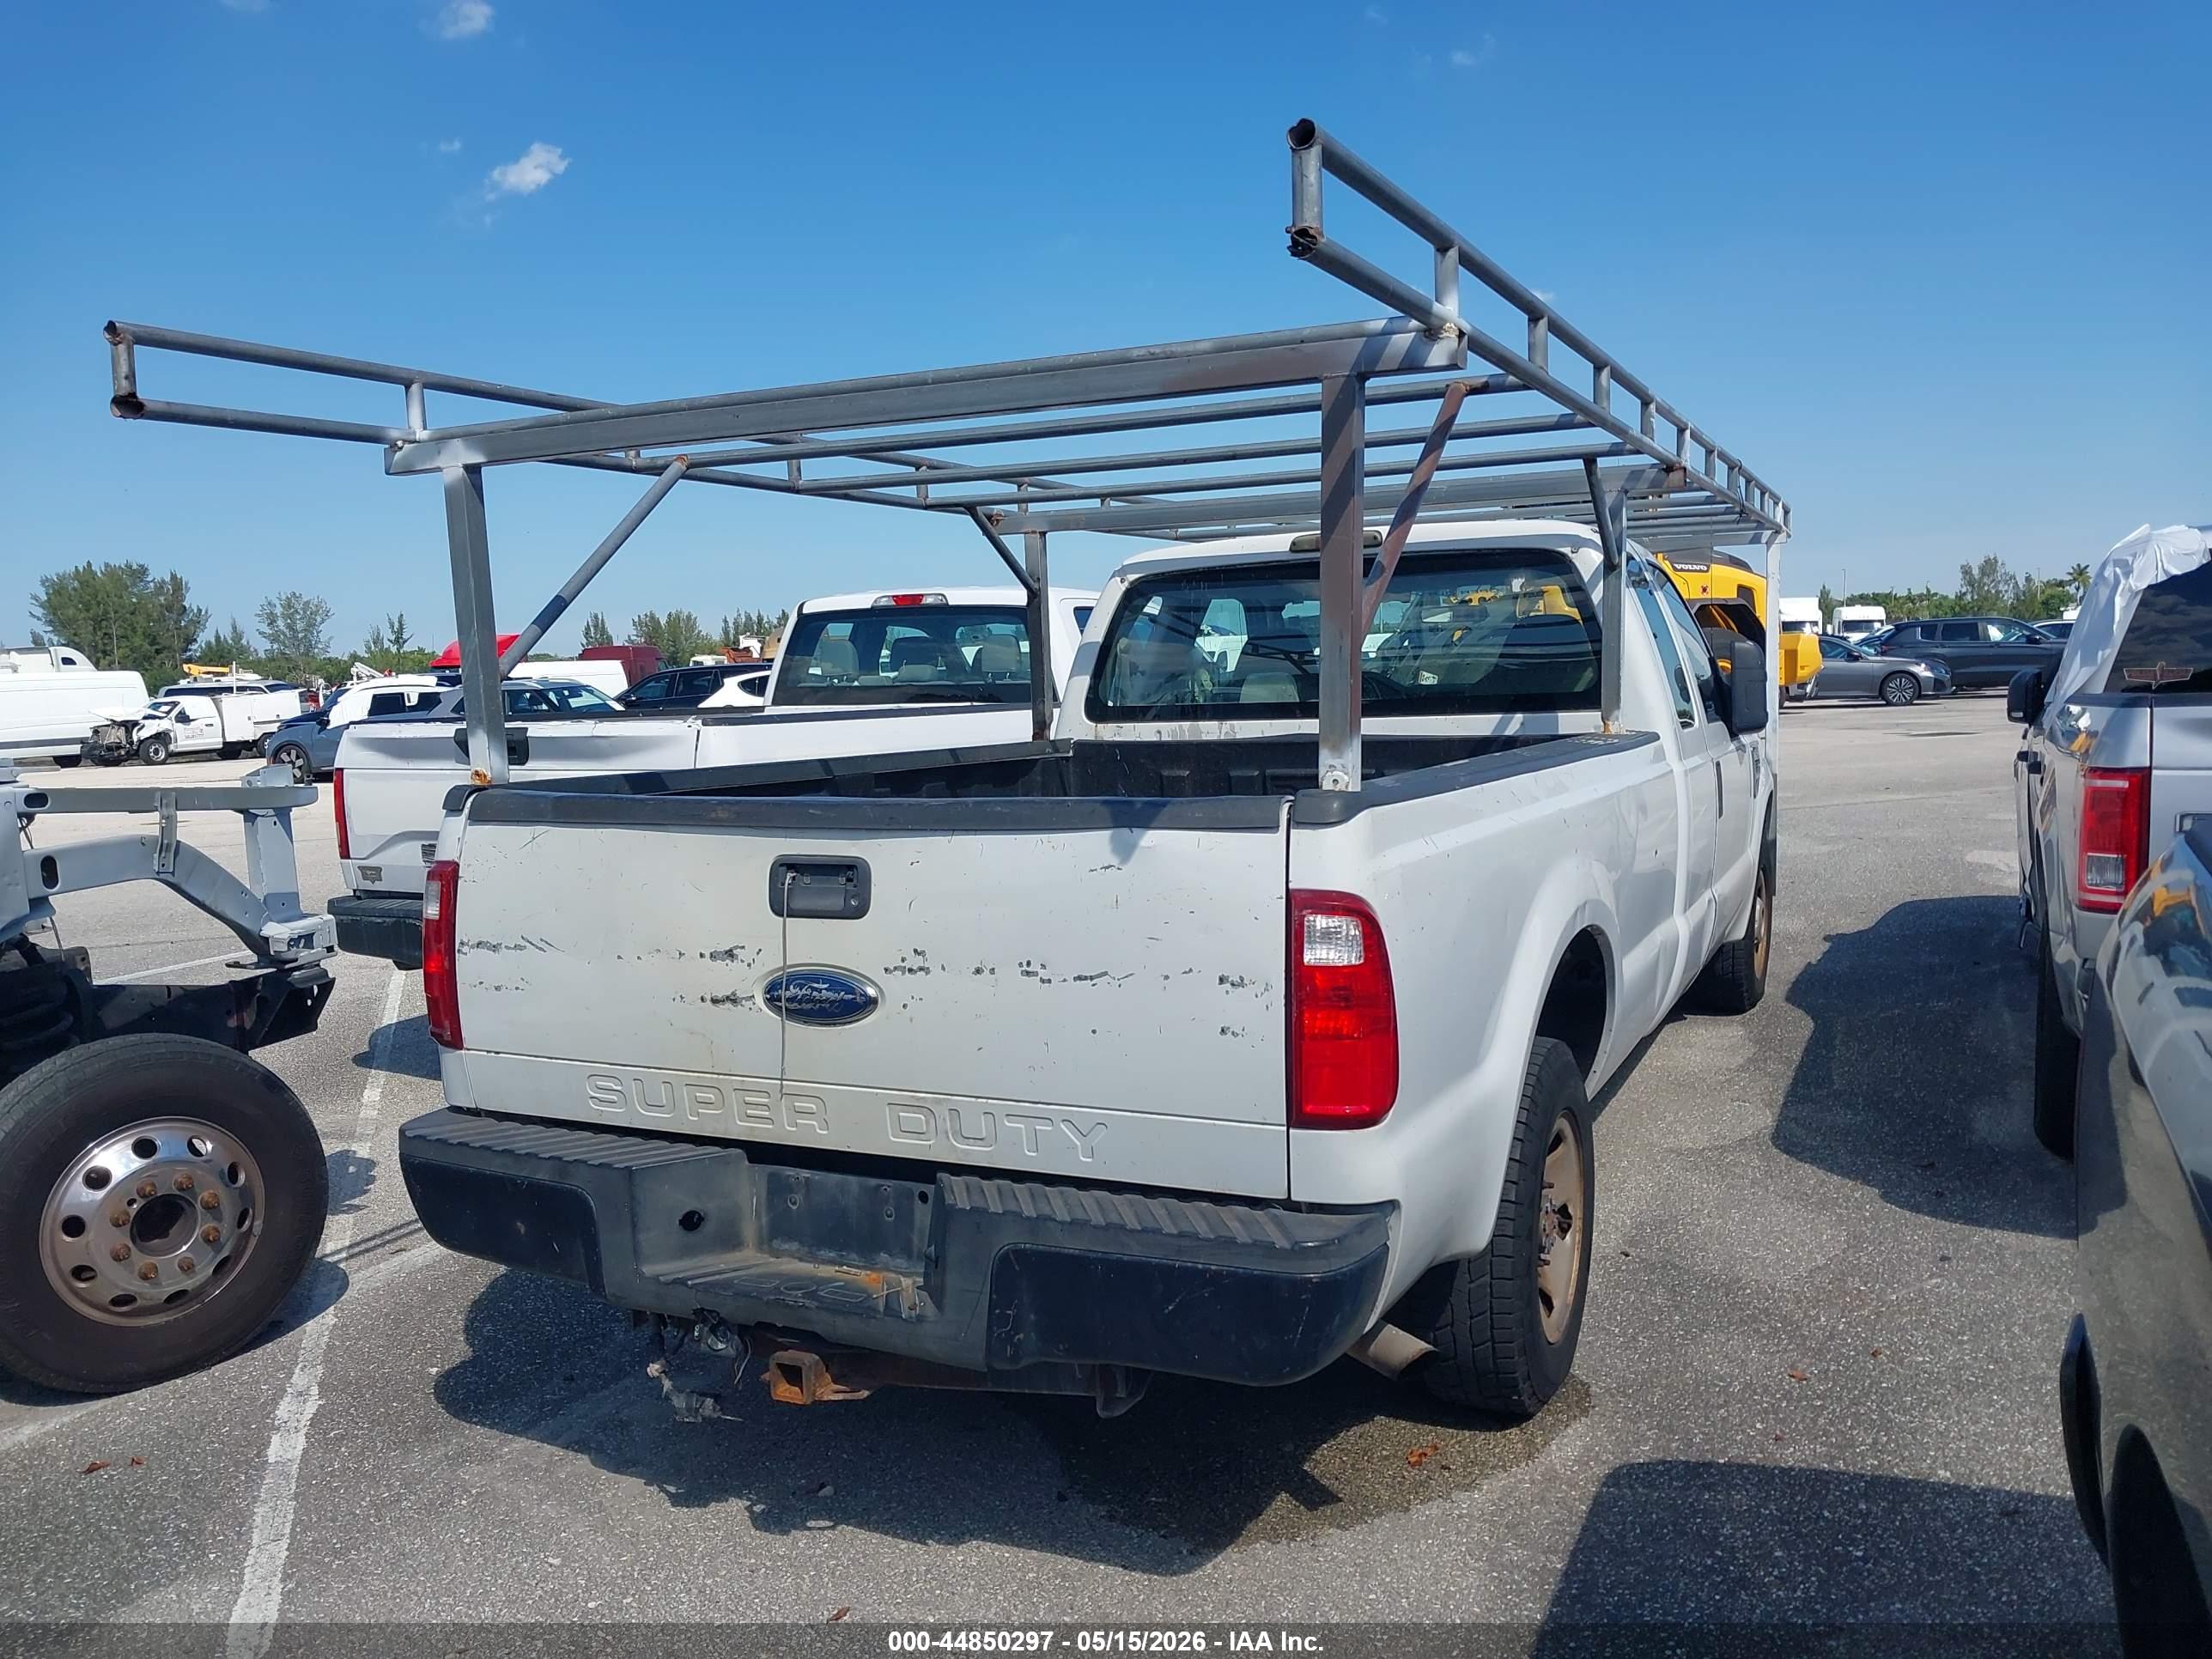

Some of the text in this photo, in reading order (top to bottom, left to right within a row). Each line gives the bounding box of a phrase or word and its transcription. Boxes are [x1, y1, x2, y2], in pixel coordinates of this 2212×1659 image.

[1674, 563, 1708, 572] VOLVO
[585, 1073, 1109, 1163] SUPER DUTY
